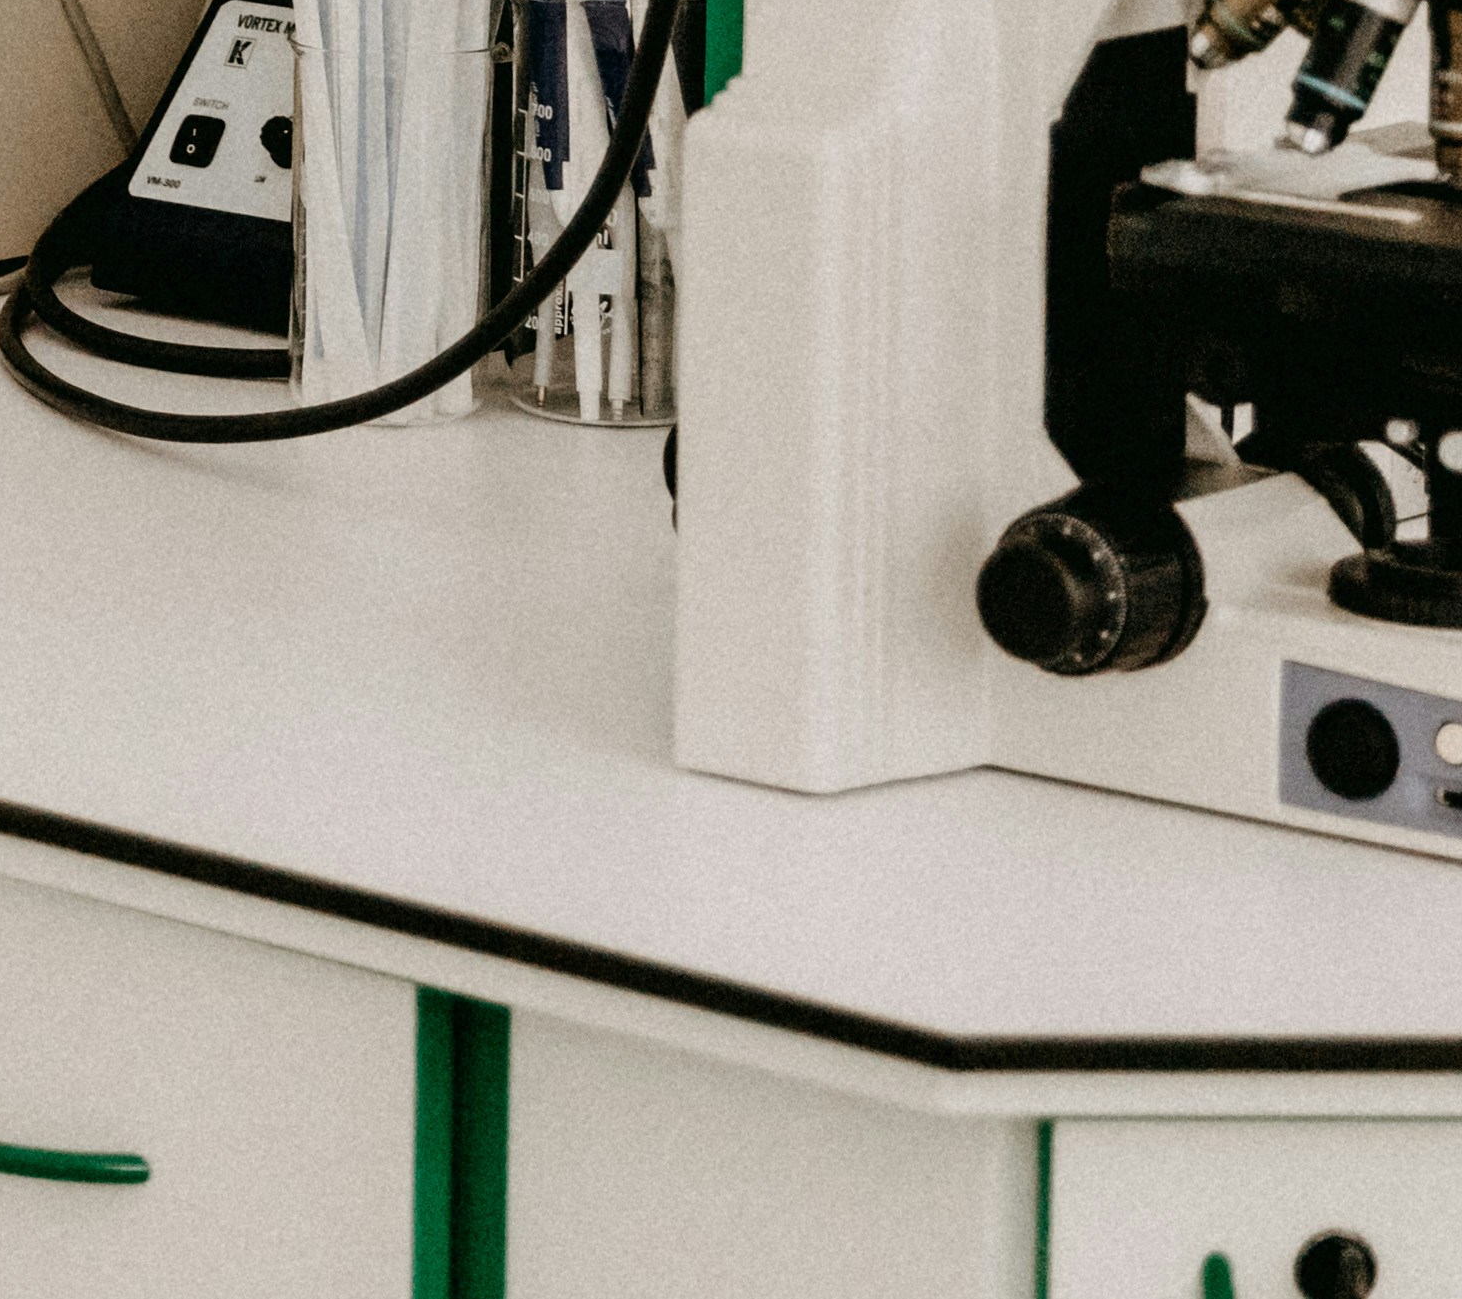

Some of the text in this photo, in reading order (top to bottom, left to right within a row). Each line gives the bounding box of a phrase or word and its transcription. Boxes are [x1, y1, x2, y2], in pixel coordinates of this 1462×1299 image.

[237, 14, 284, 34] VORTEX
[228, 39, 252, 65] K
[193, 96, 229, 110] SWITCH
[147, 175, 181, 189] VM-300
